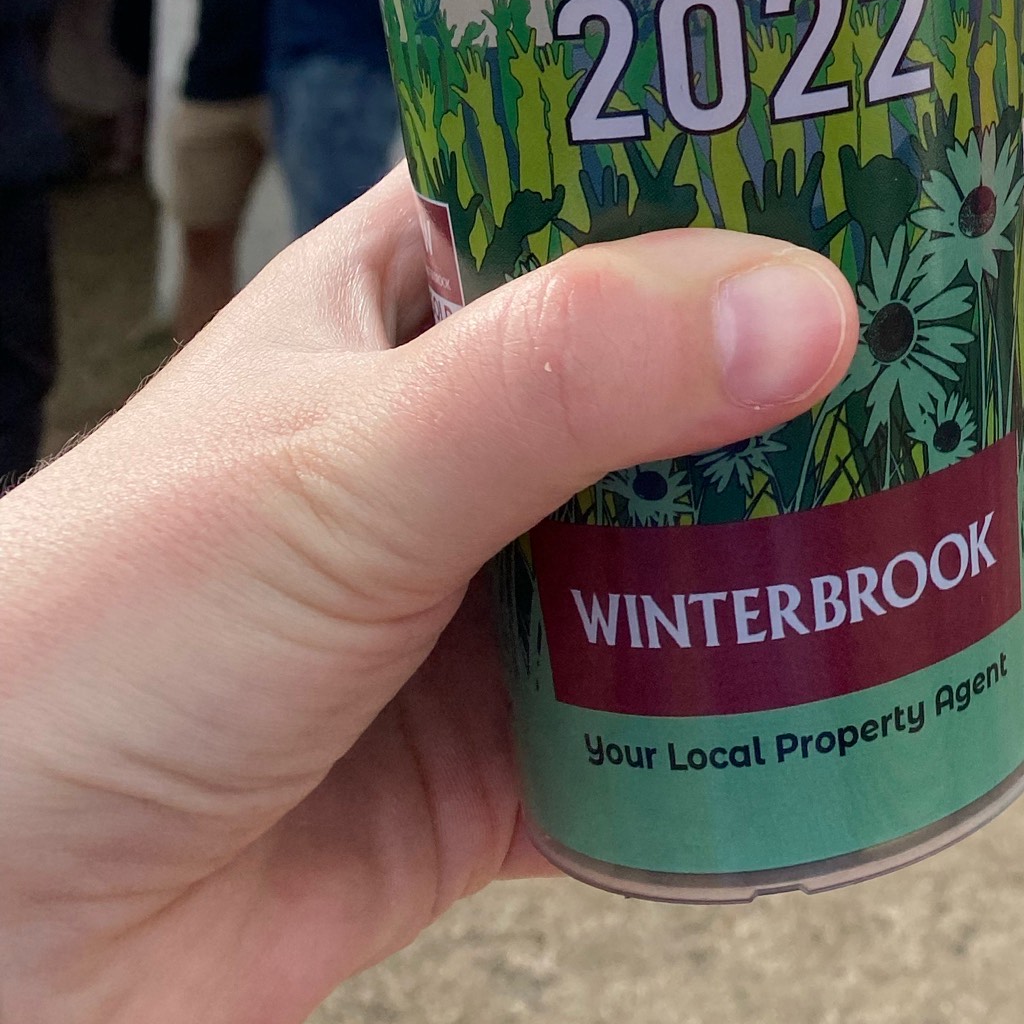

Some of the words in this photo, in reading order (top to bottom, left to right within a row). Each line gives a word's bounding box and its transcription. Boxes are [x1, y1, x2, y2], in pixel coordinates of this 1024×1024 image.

[570, 511, 998, 649] WINTERBROOK
[667, 736, 766, 771] Local
[775, 701, 925, 763] Property
[935, 652, 1008, 717] Agent
